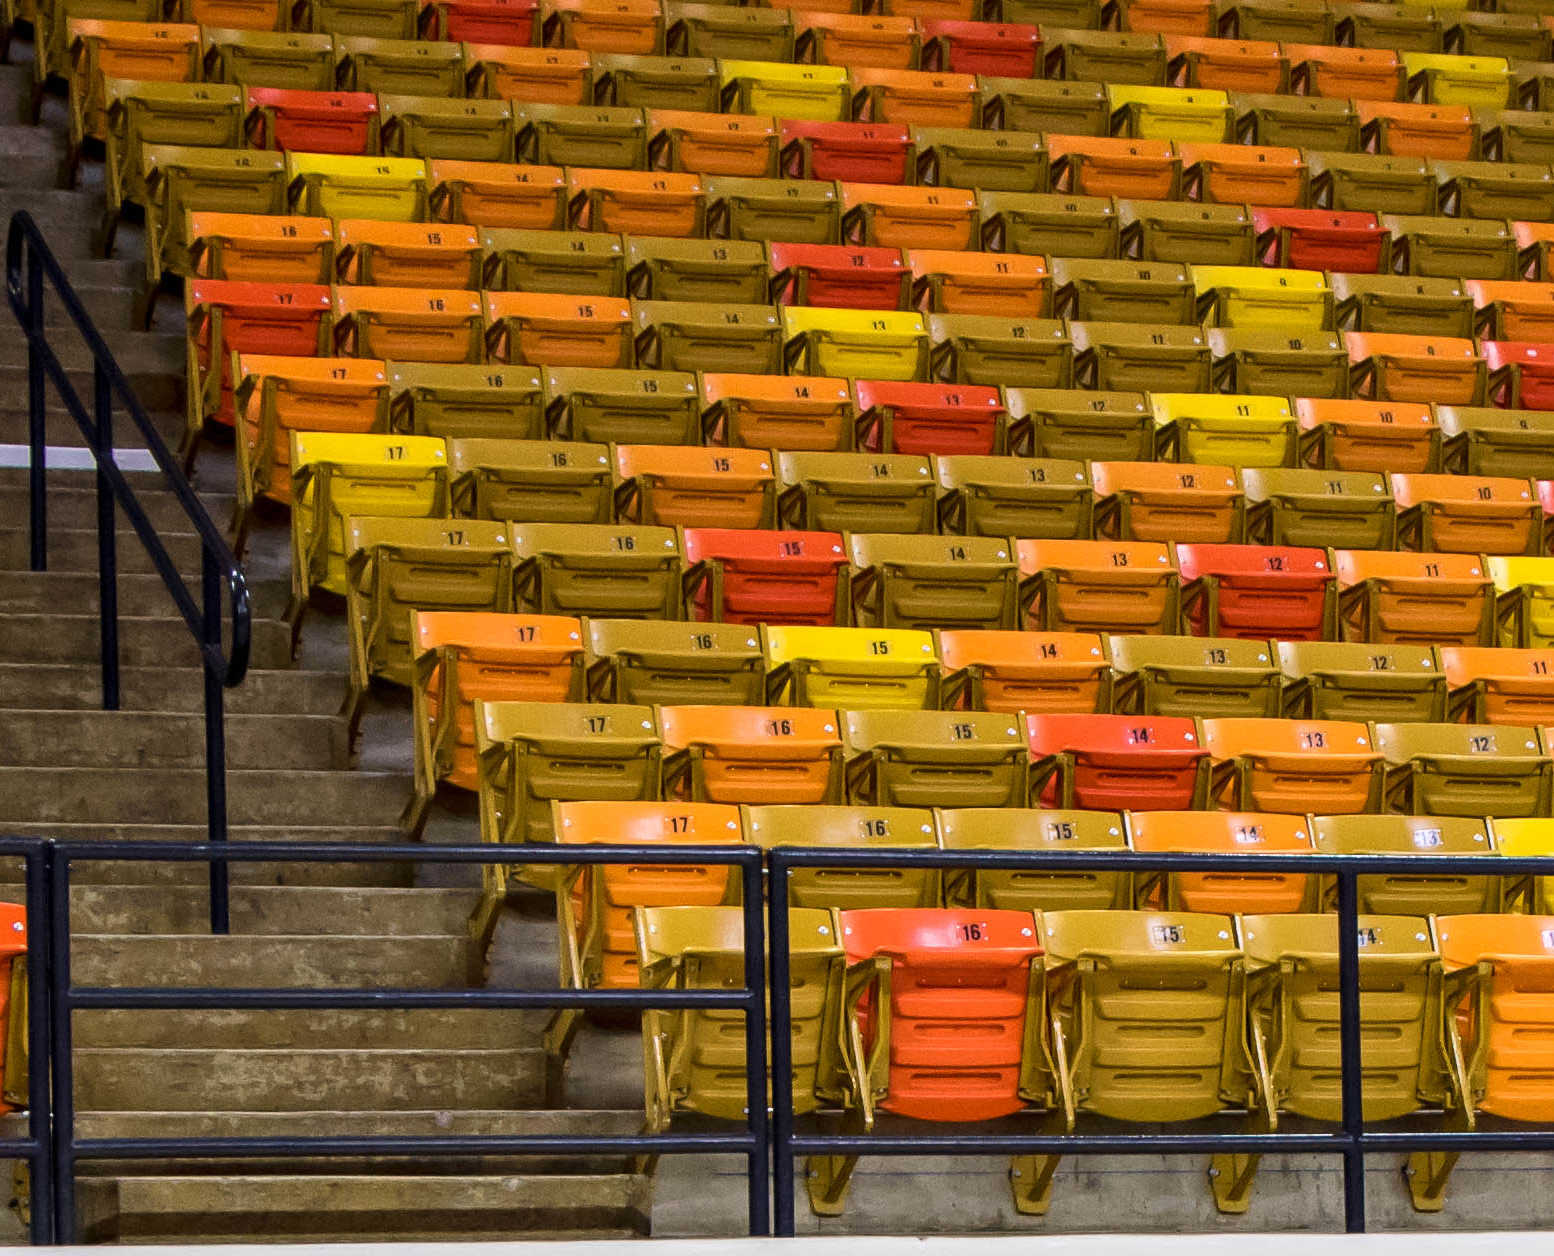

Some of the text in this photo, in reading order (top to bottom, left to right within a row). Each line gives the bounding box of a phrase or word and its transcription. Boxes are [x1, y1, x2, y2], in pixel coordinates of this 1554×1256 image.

[388, 445, 404, 460] 17
[552, 452, 568, 467] 16
[714, 458, 730, 472] 15
[873, 463, 889, 477] 14
[1030, 468, 1046, 483] 13
[1180, 474, 1195, 489] 12
[1329, 480, 1343, 495] 11
[1477, 486, 1492, 500] 10
[447, 530, 464, 546] 17
[617, 536, 635, 551] 16
[784, 541, 801, 556] 15
[950, 547, 966, 561] 14
[1112, 552, 1128, 567] 13
[1268, 556, 1283, 572] 12
[1425, 564, 1439, 577] 11
[518, 626, 535, 642] 17
[696, 634, 713, 650] 16
[871, 640, 889, 655] 15
[1041, 643, 1057, 658] 14
[1209, 649, 1226, 664] 13
[1372, 655, 1388, 670] 12
[1533, 660, 1547, 675] 11
[588, 716, 606, 733] 17
[771, 719, 791, 736] 16
[954, 723, 973, 740] 15
[1132, 727, 1149, 743] 14
[1306, 732, 1324, 748] 13
[1473, 736, 1489, 752] 12
[671, 816, 688, 833] 17
[865, 819, 886, 837] 16
[1053, 822, 1073, 840] 15
[1240, 826, 1258, 841] 14
[1422, 831, 1437, 845] 13
[962, 923, 982, 941] 16
[1162, 926, 1180, 942] 15
